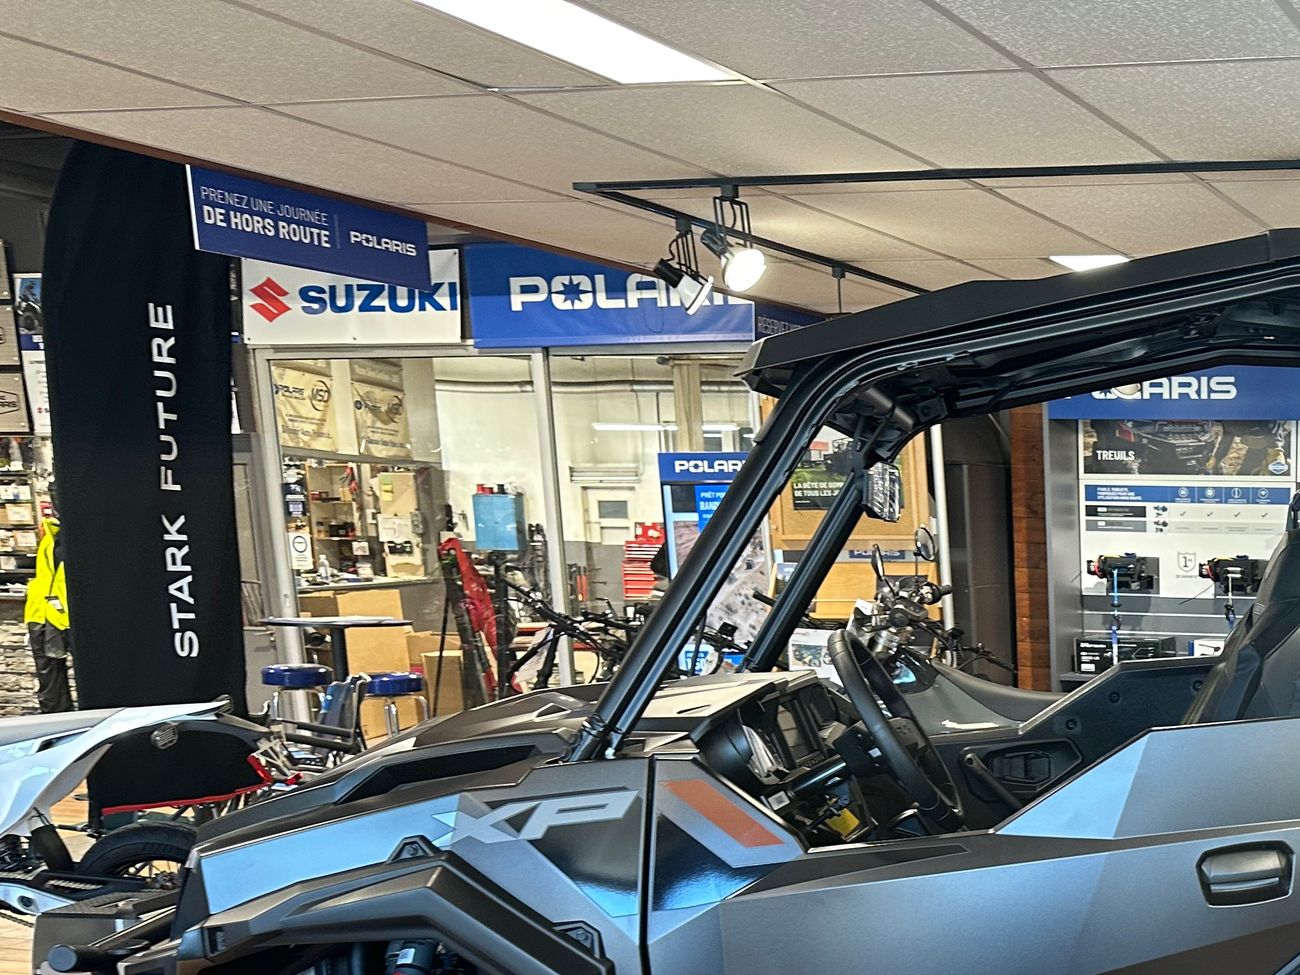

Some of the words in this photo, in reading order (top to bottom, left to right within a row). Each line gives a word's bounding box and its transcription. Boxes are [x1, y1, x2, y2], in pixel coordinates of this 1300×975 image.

[200, 186, 248, 209] PRENEZ
[250, 199, 275, 214] UNE
[276, 205, 329, 226] JOURNÉE
[203, 206, 227, 227] DE
[230, 212, 275, 237] HORS
[279, 222, 331, 248] ROUTE
[349, 231, 417, 257] POLARIS
[298, 281, 458, 315] SUZUKI
[509, 272, 754, 312] POLA
[148, 302, 182, 491] FUTURE
[674, 459, 746, 474] POLAR
[1097, 450, 1135, 462] TREUILS
[161, 514, 200, 658] STARK
[432, 790, 640, 851] XP
